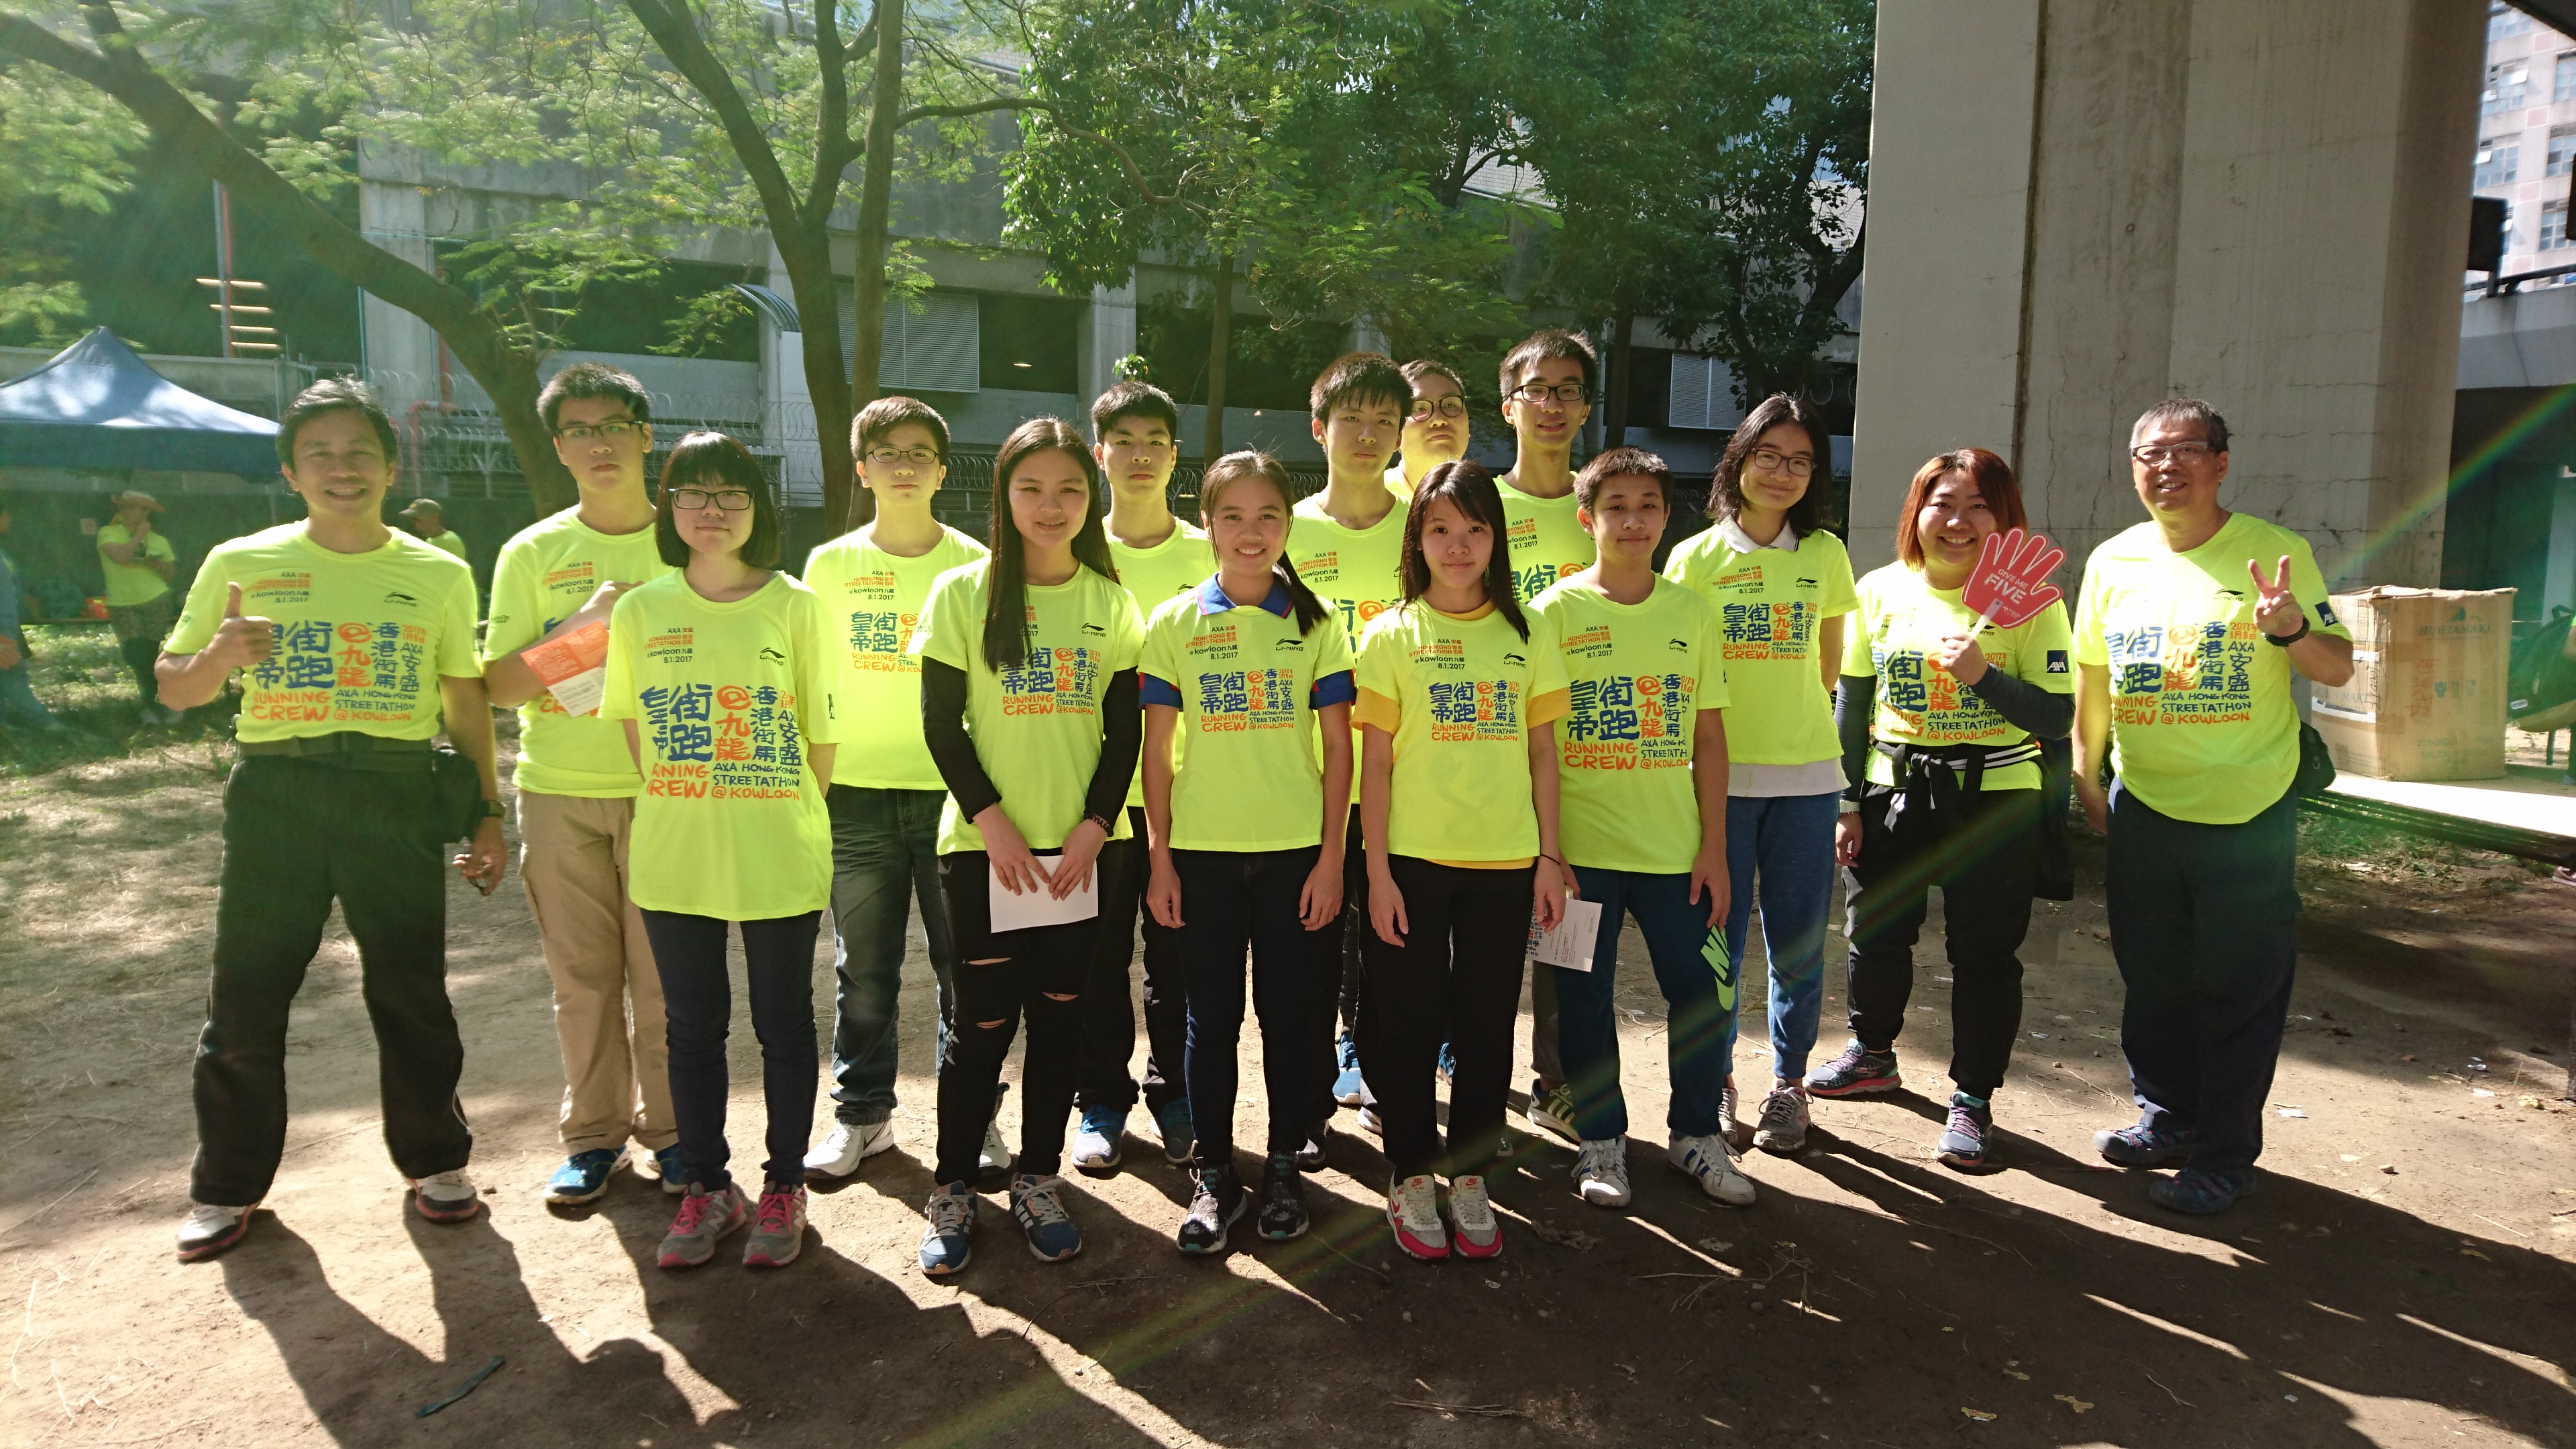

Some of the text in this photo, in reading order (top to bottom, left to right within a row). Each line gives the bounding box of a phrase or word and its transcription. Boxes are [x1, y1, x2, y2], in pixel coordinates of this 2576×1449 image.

[1514, 541, 1538, 549] 8.1.2017
[1295, 563, 1328, 574] TREETATHON
[1299, 559, 1327, 568] HONGKONG
[1998, 569, 2029, 589] GIVE ME
[1984, 572, 2027, 604] FIVE
[1568, 632, 1599, 641] HONGKONG
[1186, 639, 1226, 648] STREETATHON
[1561, 637, 1600, 648] STREETATHON
[2228, 641, 2255, 652] AXA
[400, 642, 423, 655] AXA
[852, 653, 896, 661] RUNNING
[1587, 650, 1612, 658] 8.1.2017
[1723, 650, 1770, 659] CREW
[854, 660, 896, 672] CREW
[2047, 661, 2066, 671] AXA
[253, 691, 331, 704] RUNNING
[364, 690, 392, 698] HONG
[1003, 694, 1055, 704] RUNNING
[2162, 692, 2184, 700] AXA
[2188, 692, 2220, 700] HONG
[336, 700, 415, 710] STREETATHON
[1004, 704, 1054, 715] CREW
[2161, 702, 2251, 712] STREETATHON
[251, 705, 329, 721] CREW
[1201, 714, 1247, 722] RUNNING
[1953, 711, 1979, 719] HONG
[1202, 722, 1247, 732] CREW
[1432, 723, 1475, 731] RUNNING
[1928, 718, 2005, 731] STREETATHON
[1432, 732, 1474, 741] CREW
[1564, 741, 1638, 754] RUNNING
[1641, 739, 1658, 747] AXA
[1565, 755, 1638, 770] CREW
[713, 762, 800, 775] AXA HONG KONG
[713, 775, 799, 787] STREETATHON
[647, 779, 708, 798] REW
